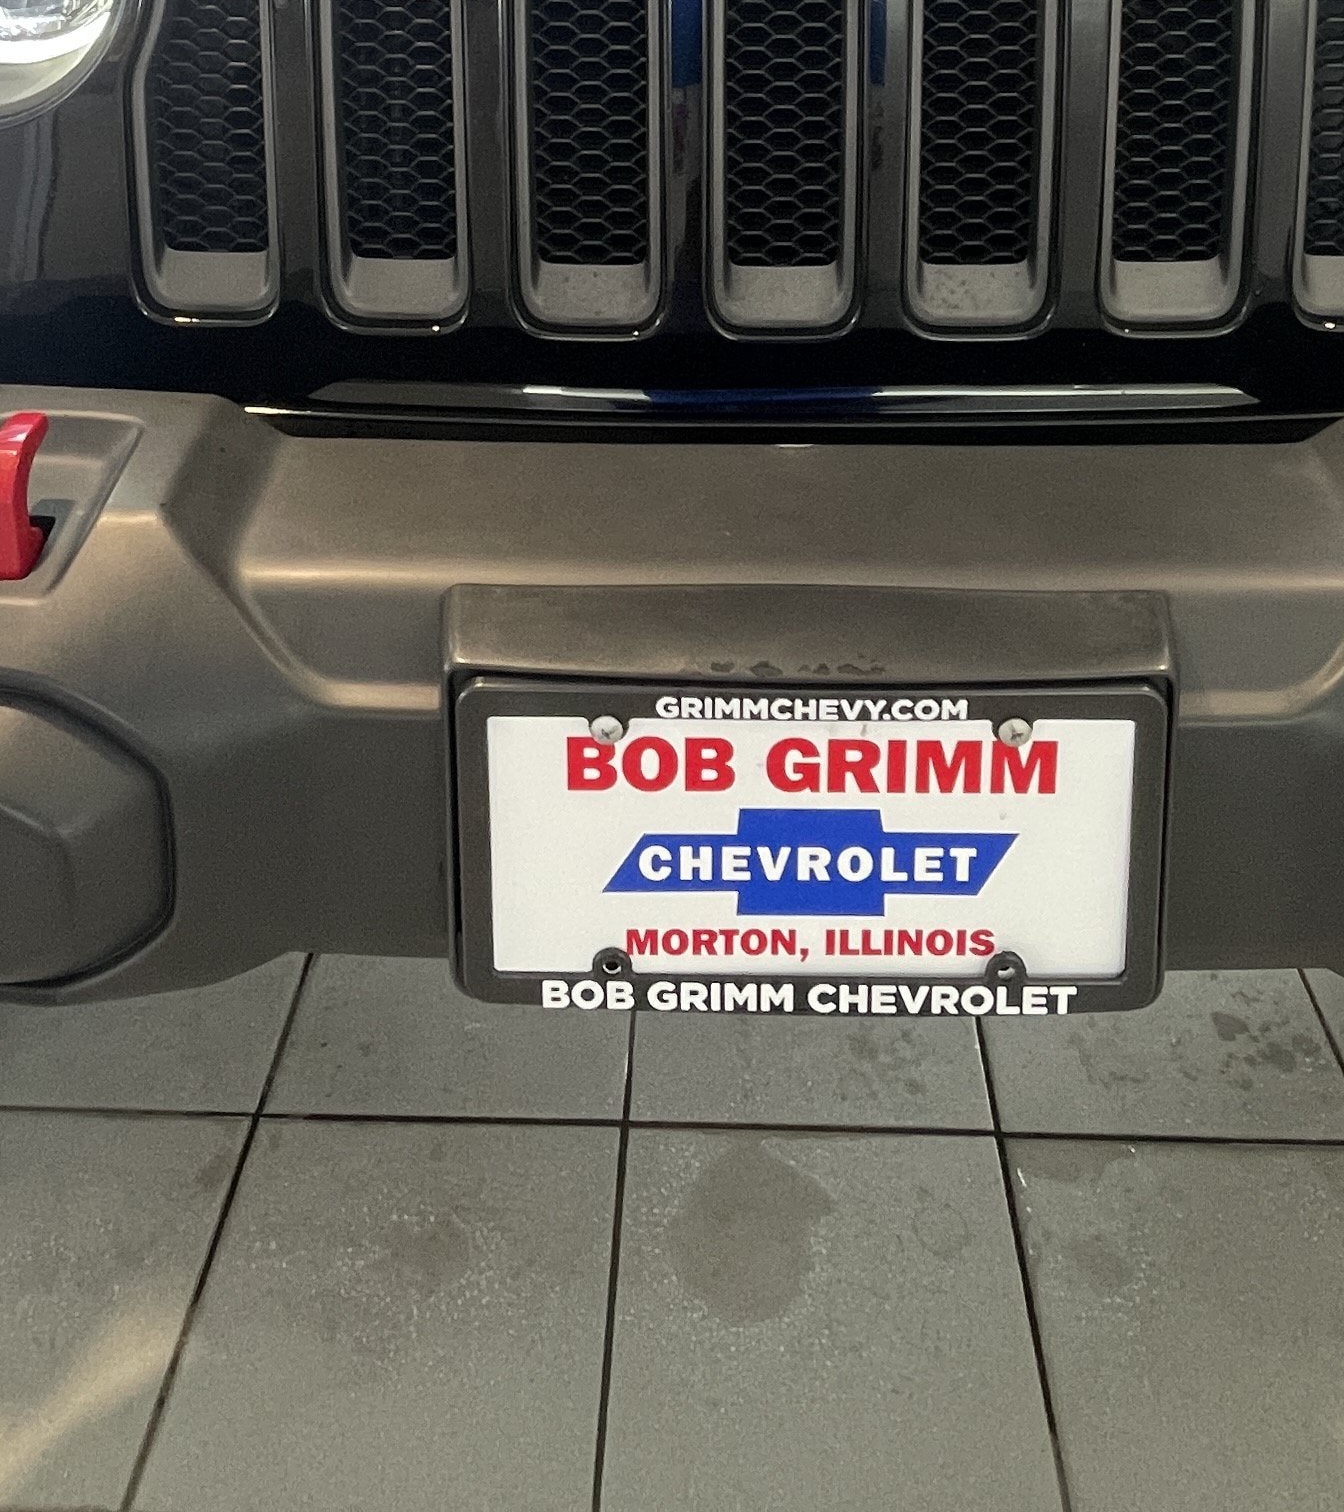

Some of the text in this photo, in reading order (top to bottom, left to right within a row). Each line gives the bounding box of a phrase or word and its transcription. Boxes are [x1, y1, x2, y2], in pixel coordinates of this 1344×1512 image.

[655, 696, 970, 721] GRIMMCHEVY.COM
[566, 736, 1059, 795] BOB GRIMM
[637, 844, 980, 883] CHEVROLET
[625, 929, 996, 961] MORTON, ILLINOIS
[541, 979, 1079, 1017] BOB GRIMM CHEVROLET
